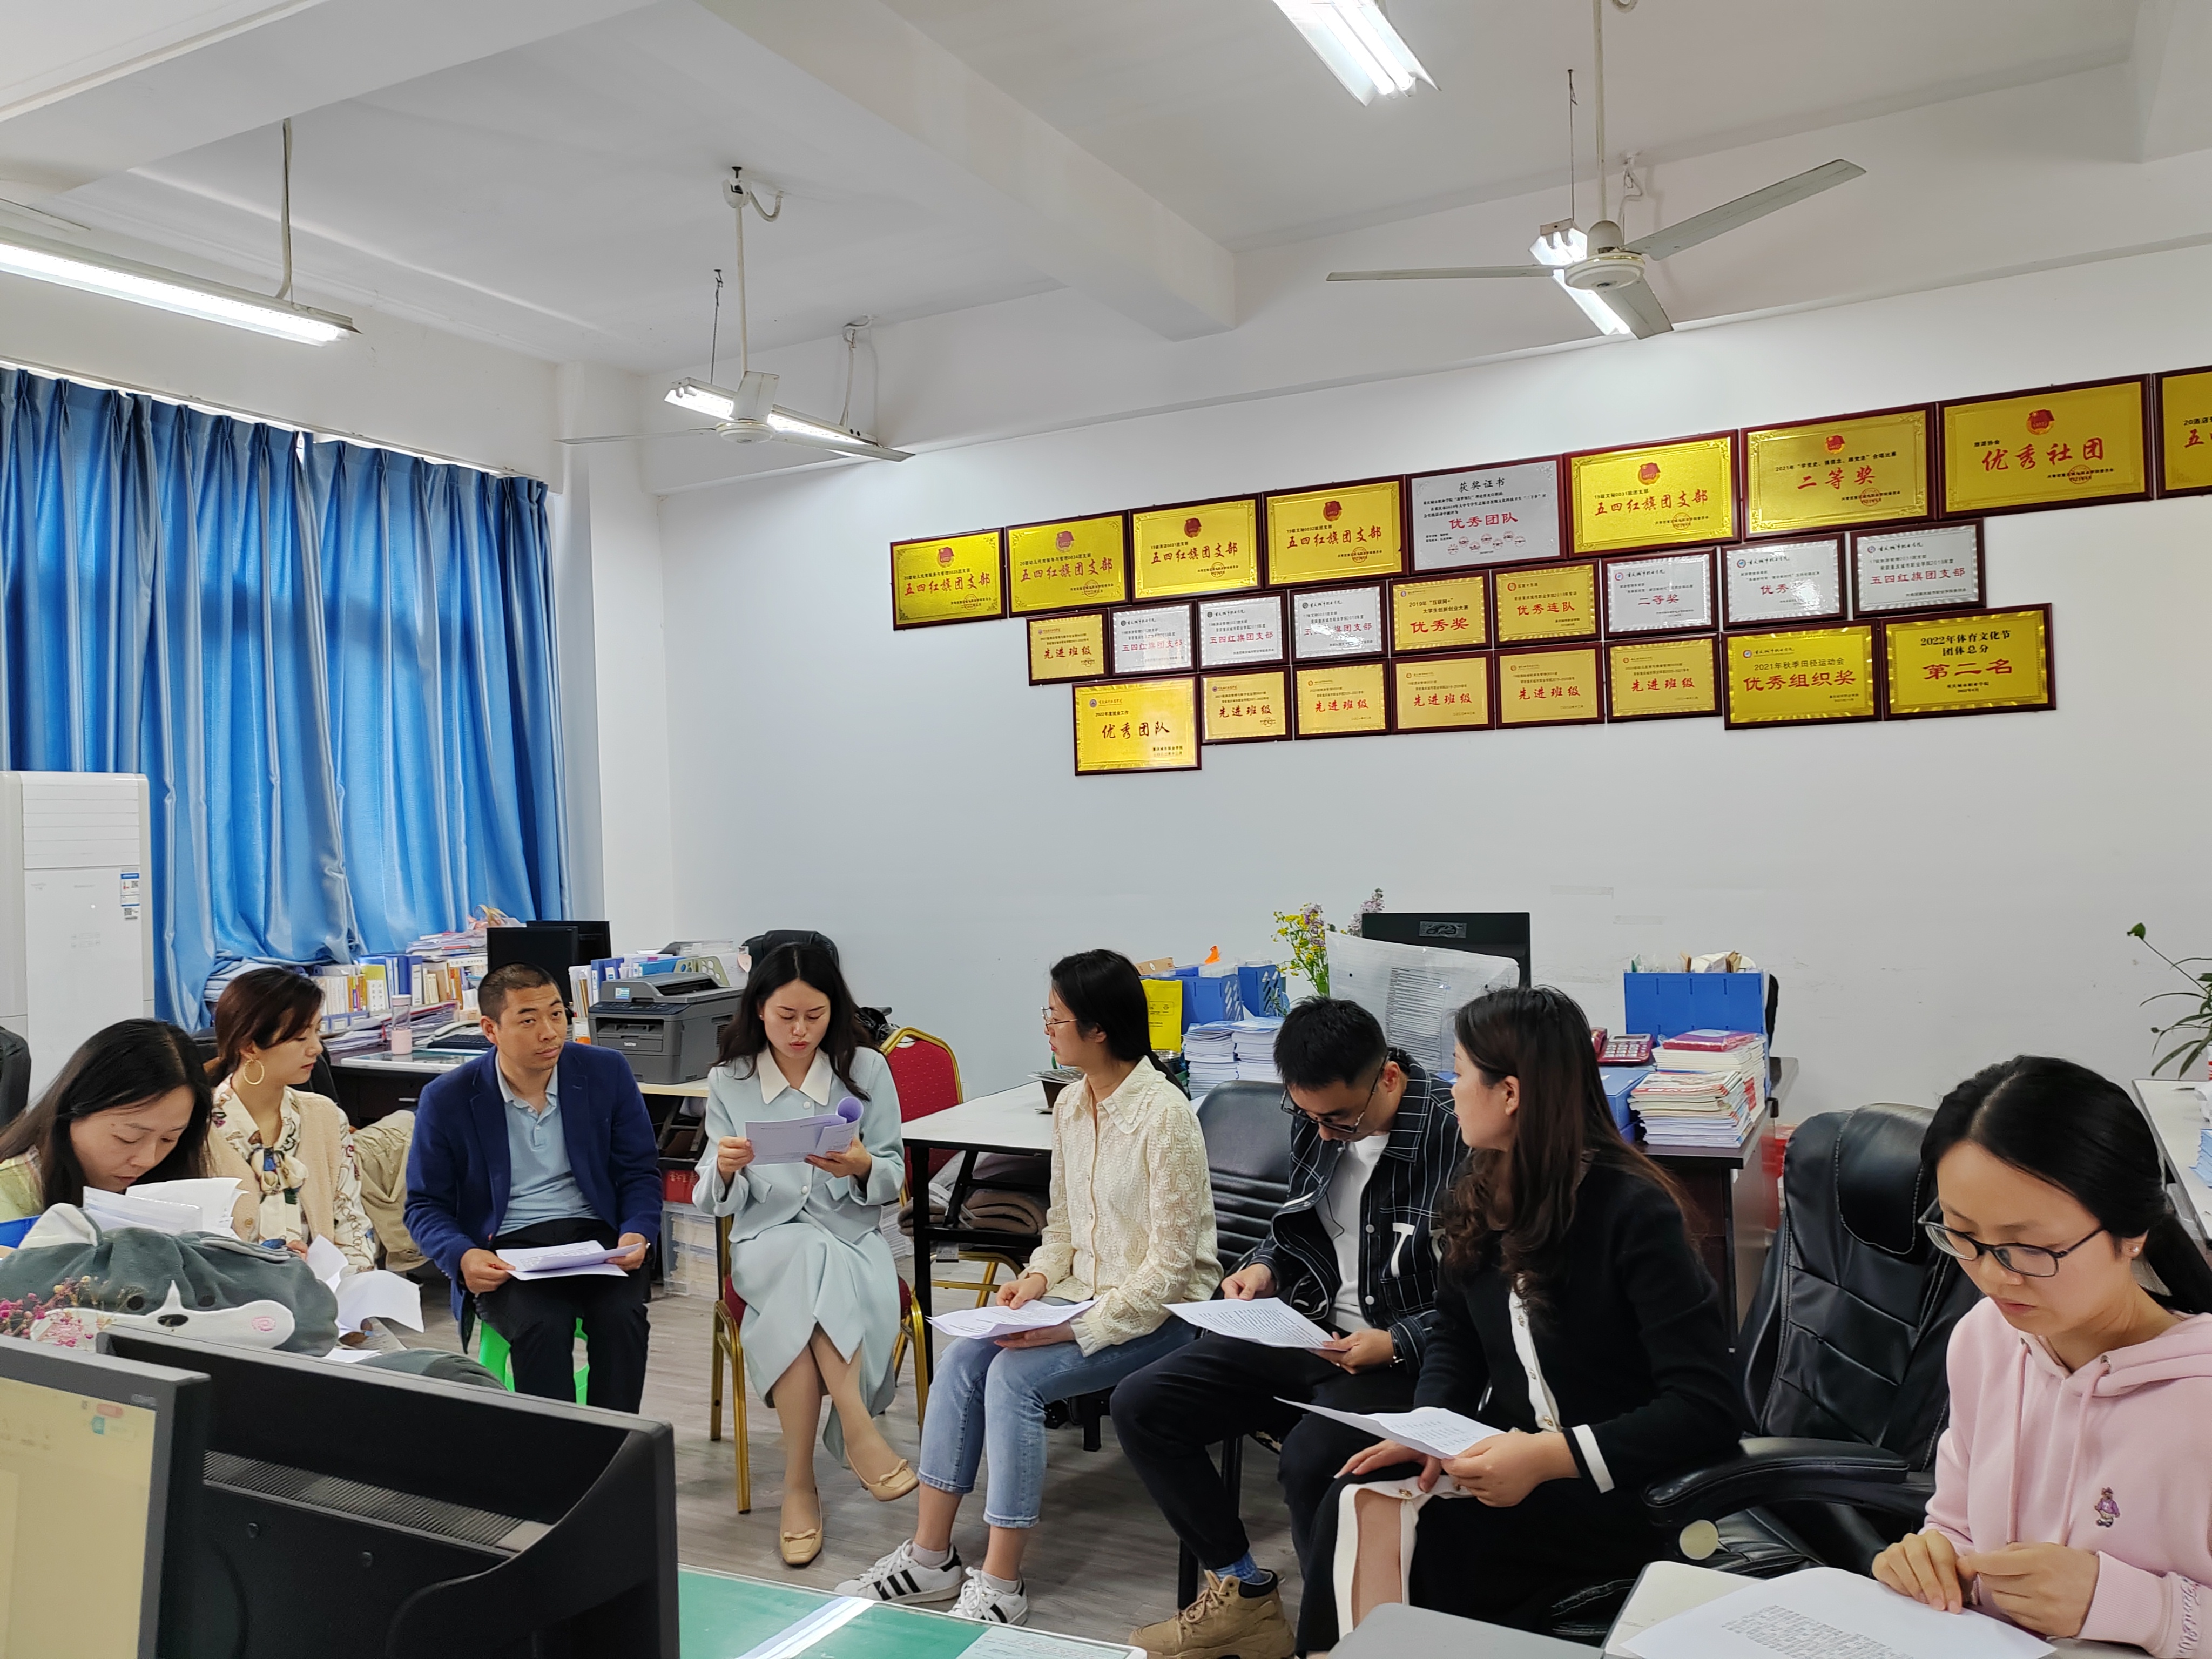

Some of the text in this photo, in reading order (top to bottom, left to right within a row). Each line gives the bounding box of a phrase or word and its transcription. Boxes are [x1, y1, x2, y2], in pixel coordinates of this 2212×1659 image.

[1982, 437, 2103, 471] 优秀社团
[1459, 477, 1505, 493] 获奖证书
[1797, 465, 1876, 490] 二等奖
[1595, 489, 1708, 516] 五四红旗团支部
[1448, 512, 1518, 529] 优秀团队
[1287, 525, 1381, 549] 五四红旗团支部
[1151, 541, 1238, 564] 五四红旗团支部
[1021, 557, 1112, 582] 五四红旗团支部
[1870, 568, 1965, 584] 五四红旗团支部
[905, 572, 990, 596] 五四红旗团支部
[1638, 594, 1679, 605] 二等奖
[1423, 605, 1468, 614] 大学生创新创业大赛
[1517, 601, 1575, 616] 优秀连队
[1410, 617, 1469, 633] 优秀奖
[1210, 631, 1273, 644] 五四红旗团支部
[1920, 630, 2011, 646] 2022年体育文化节
[1044, 646, 1092, 659] 先进班级
[1943, 644, 1989, 656] 团体总分
[1754, 657, 1845, 671] 2021年秋季田径运动会
[1923, 658, 2012, 680] 第二名
[1631, 677, 1695, 692] 先进班级
[1743, 669, 1856, 692] 优秀组织奖
[1413, 693, 1472, 707] 先进班级
[1519, 686, 1581, 700] 先进班级
[1219, 704, 1272, 718] 先进班级
[1315, 699, 1368, 712] 先进班级
[1102, 721, 1170, 739] 优秀团队
